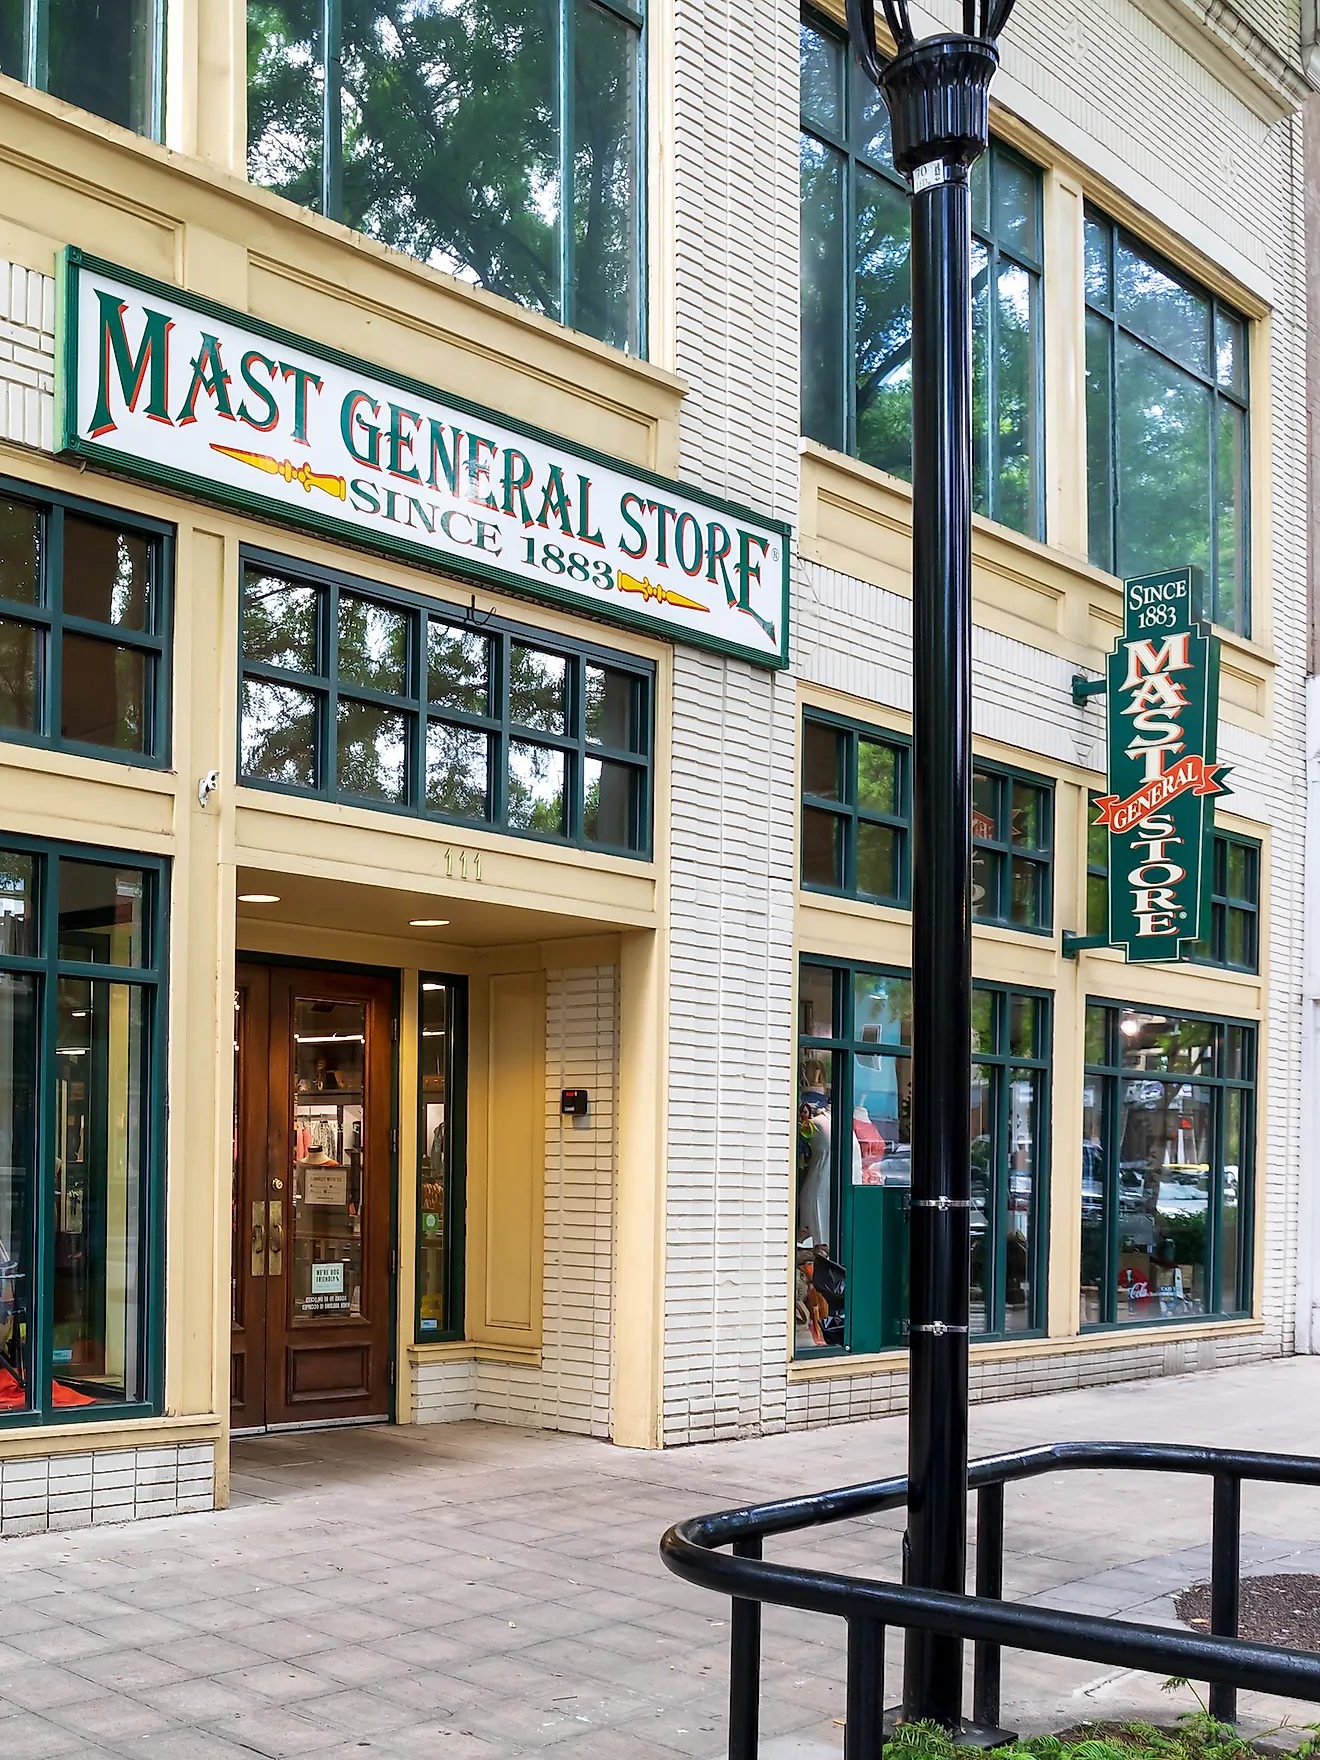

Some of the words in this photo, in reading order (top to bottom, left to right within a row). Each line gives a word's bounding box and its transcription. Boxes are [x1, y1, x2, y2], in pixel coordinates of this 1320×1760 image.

[87, 288, 324, 448] MAST
[340, 389, 608, 549] GENERAL
[619, 491, 777, 645] STORE
[349, 478, 504, 556] SINCE
[521, 534, 615, 591] 1883
[1128, 579, 1187, 611] SINCE
[1138, 604, 1177, 629] 1883
[1118, 632, 1194, 784] MAST
[1113, 761, 1199, 831] GENERAL
[444, 847, 482, 881] 111
[1127, 813, 1187, 938] STORE
